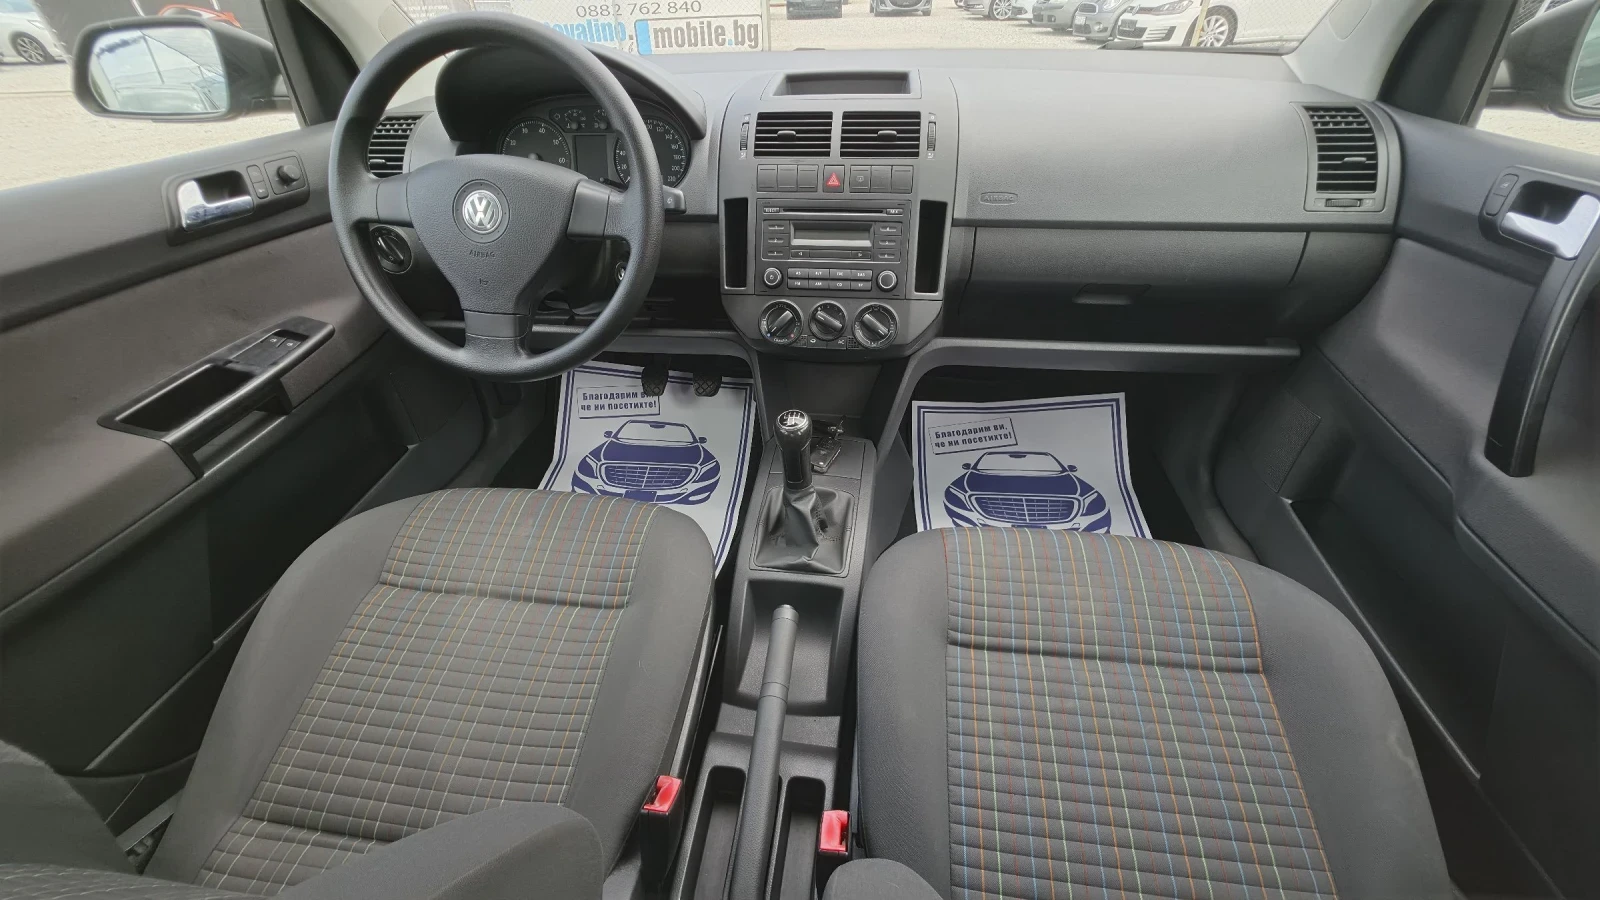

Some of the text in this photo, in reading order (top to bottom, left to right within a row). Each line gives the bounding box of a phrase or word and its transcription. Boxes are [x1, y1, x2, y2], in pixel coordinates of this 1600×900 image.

[576, 0, 702, 18] 0882 762 840
[652, 20, 759, 49] mobile.bg
[582, 391, 638, 401] Благодарим
[594, 403, 606, 411] ни
[607, 400, 657, 411] посетихте!
[934, 425, 992, 439] Благодарим
[961, 431, 1012, 445] посетихте!
